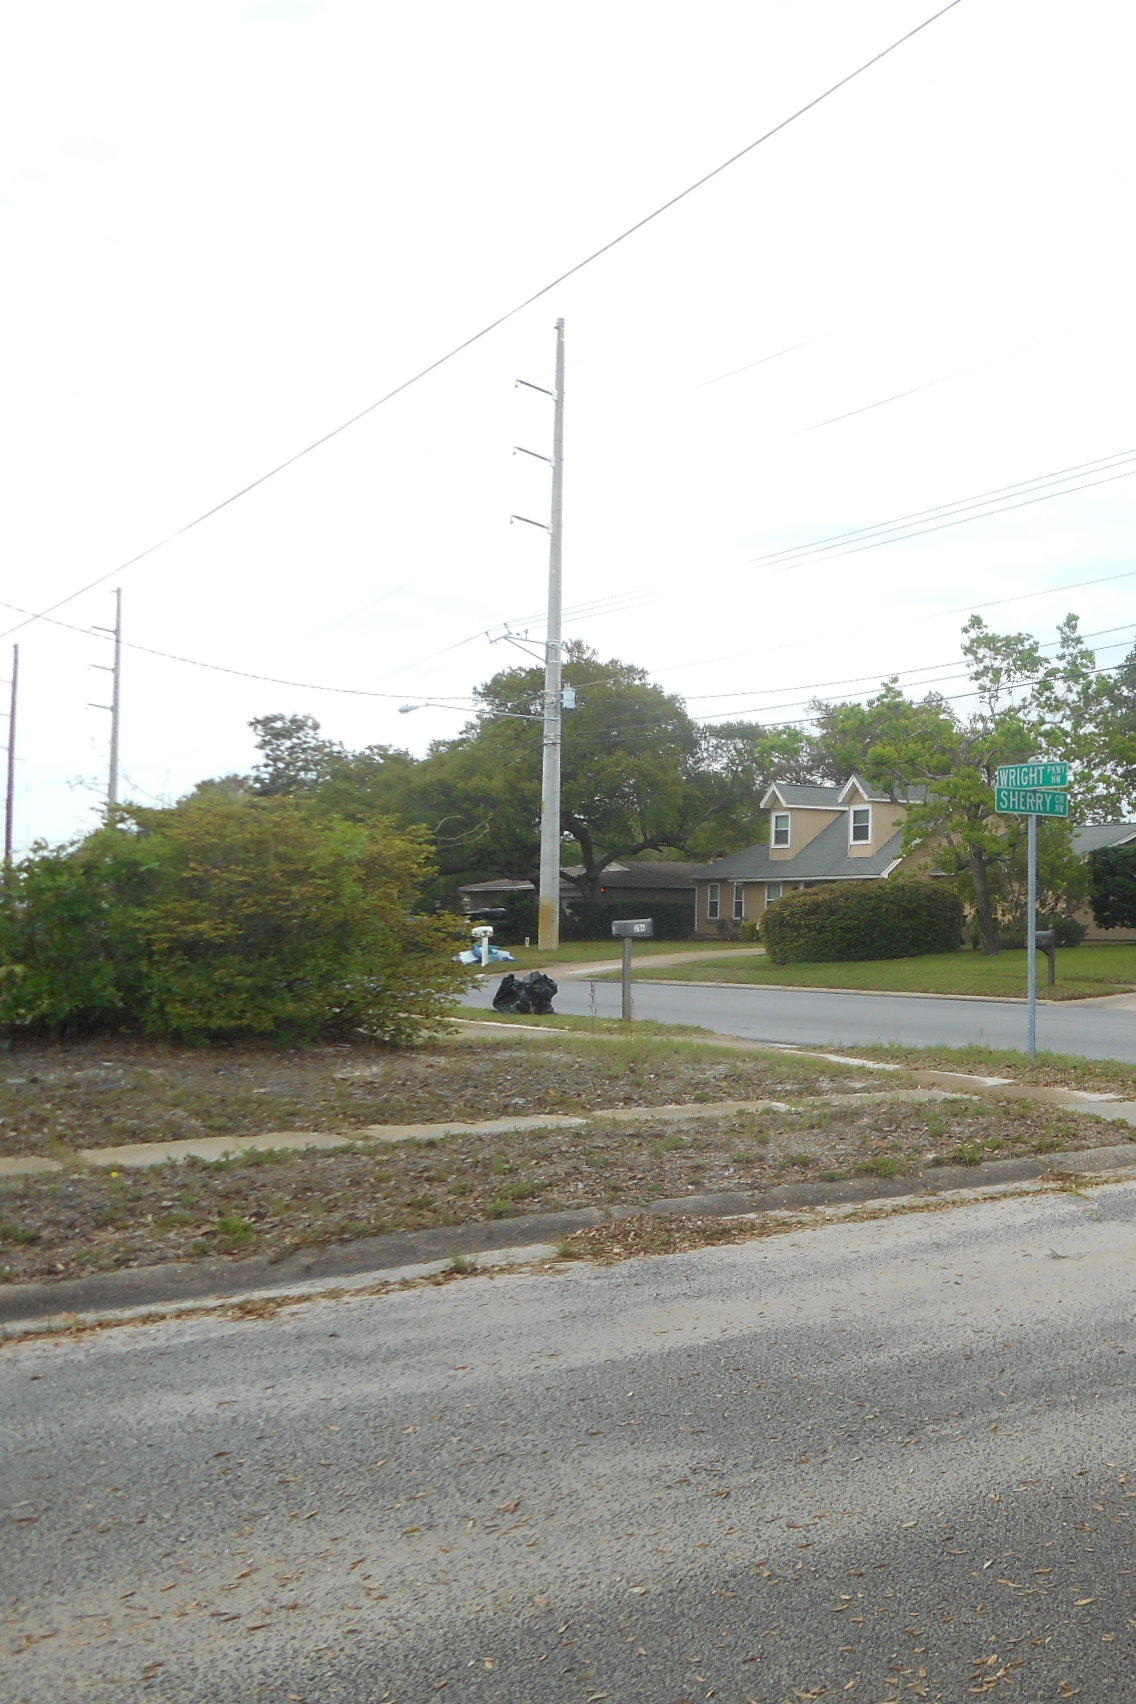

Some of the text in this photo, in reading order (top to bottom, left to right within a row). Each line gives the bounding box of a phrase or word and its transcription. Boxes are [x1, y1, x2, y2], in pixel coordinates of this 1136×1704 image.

[1000, 765, 1065, 786] WRIGHT PKWY
[1051, 775, 1061, 784] NW
[1000, 790, 1052, 811] SHERRY
